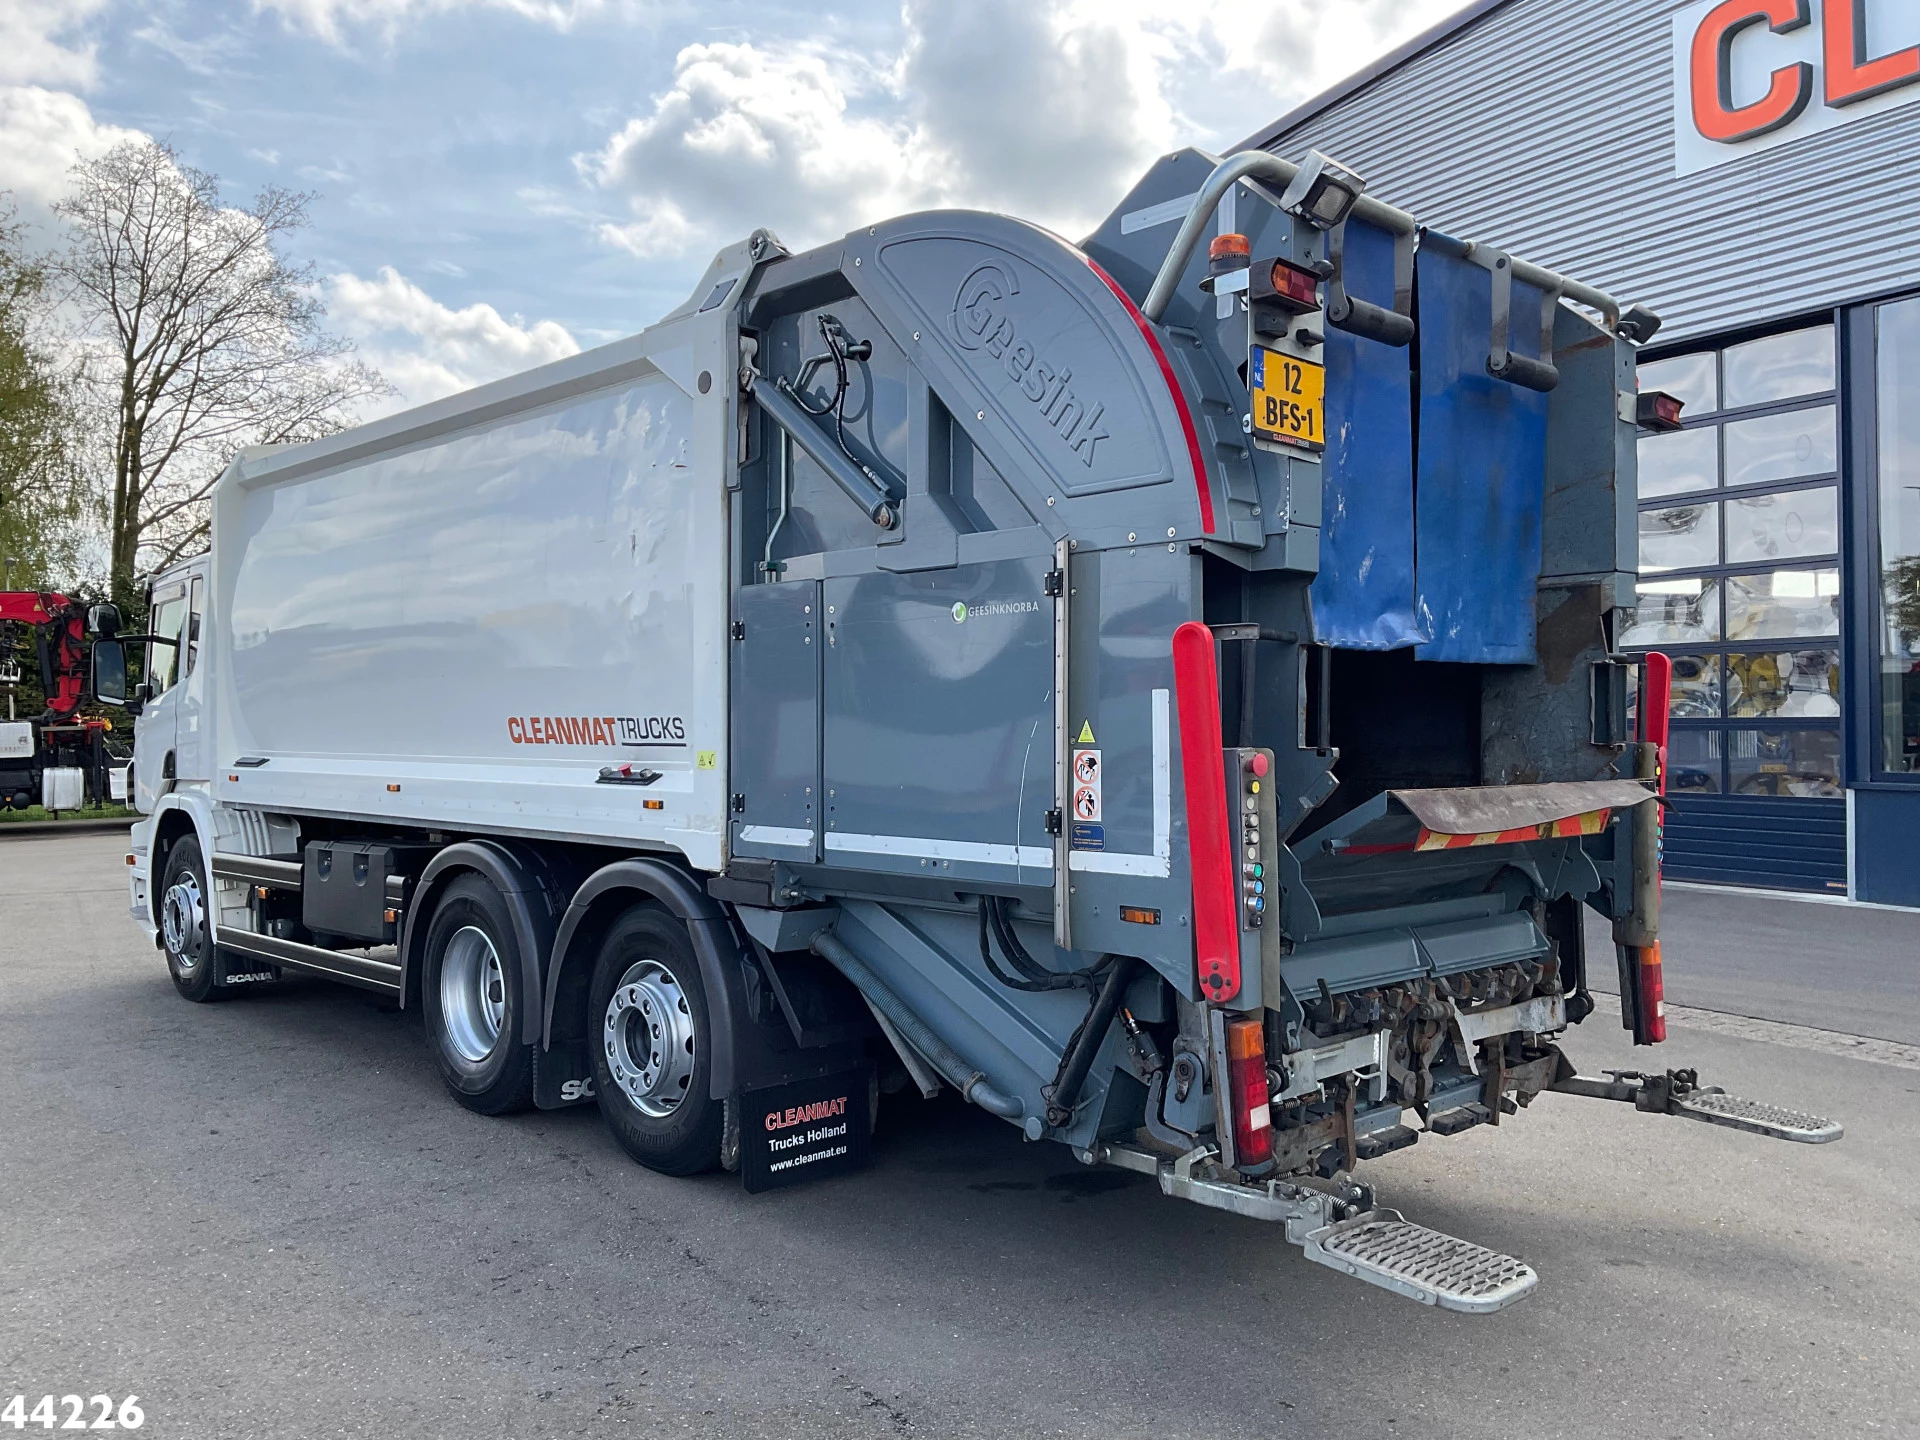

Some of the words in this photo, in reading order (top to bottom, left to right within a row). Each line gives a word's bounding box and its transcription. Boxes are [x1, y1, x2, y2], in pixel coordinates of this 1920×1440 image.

[948, 259, 1110, 468] Geesink
[1254, 372, 1263, 382] NL
[1284, 362, 1303, 395] 12
[1266, 395, 1313, 437] BFS-1
[968, 601, 1039, 617] GEESINKNORBA
[507, 717, 616, 746] CLEANMAT
[617, 717, 685, 740] TRUCKS
[226, 972, 273, 984] SCANIA
[765, 1097, 847, 1131] CLEANMAT
[768, 1134, 805, 1152] Trucks
[807, 1122, 847, 1143] Holland
[770, 1145, 847, 1172] www.cleanmat.eu
